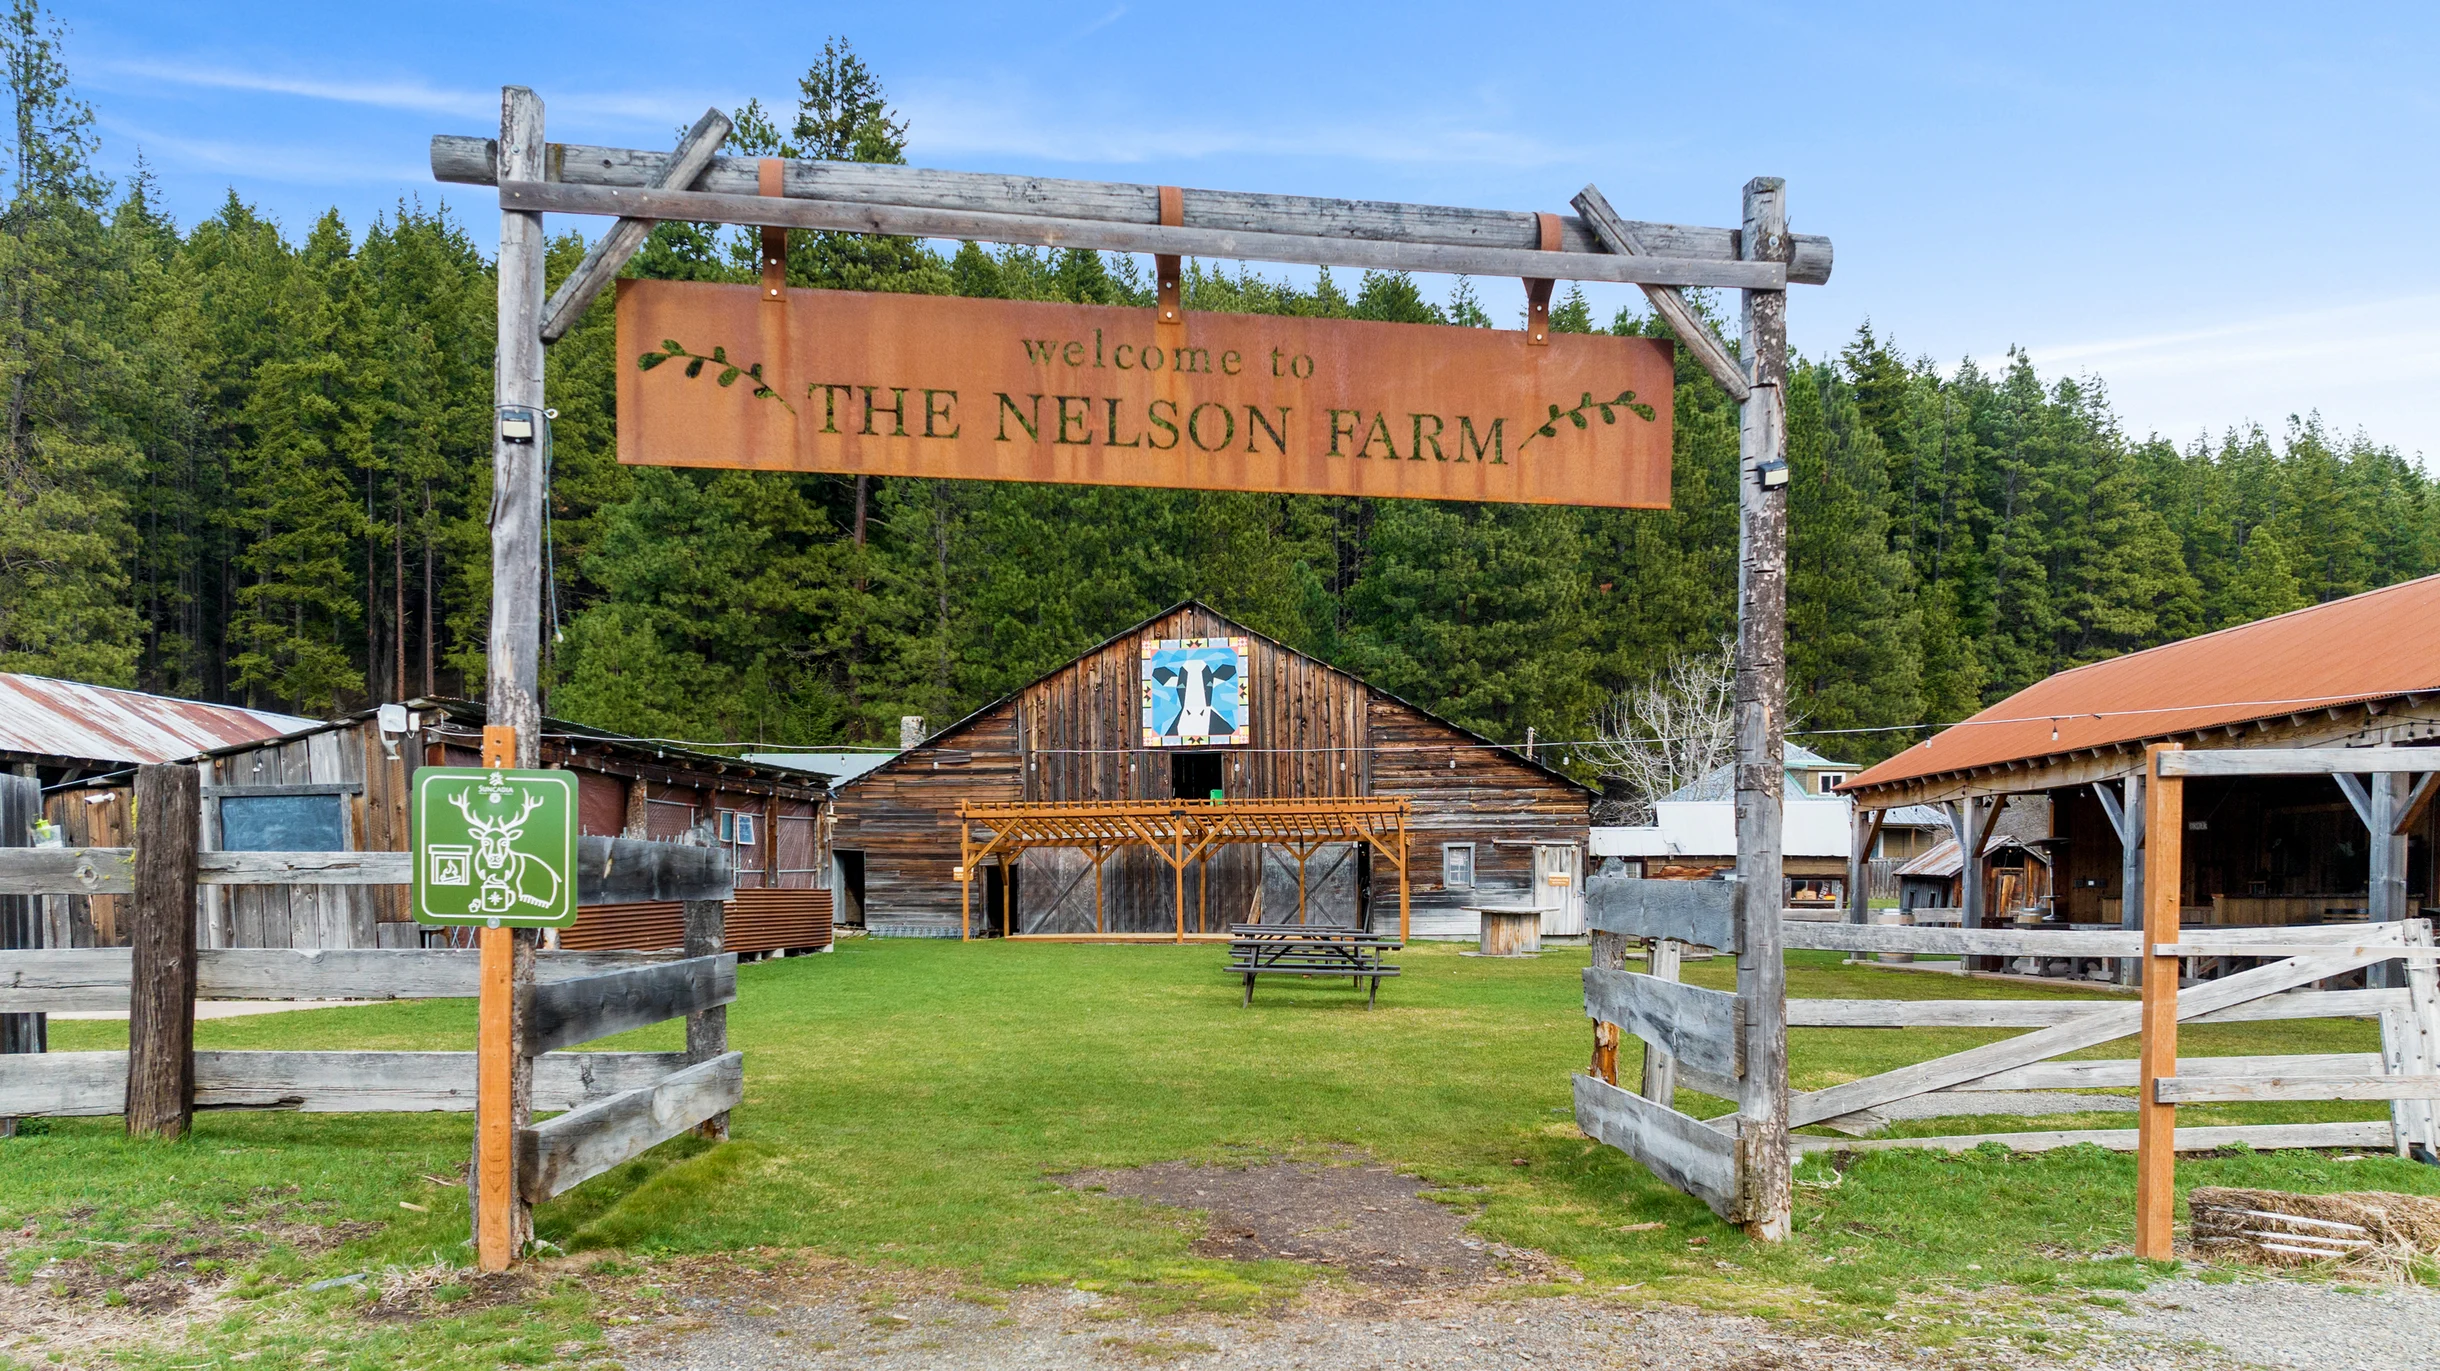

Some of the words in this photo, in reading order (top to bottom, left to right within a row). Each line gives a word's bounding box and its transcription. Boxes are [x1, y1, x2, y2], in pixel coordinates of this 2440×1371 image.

[1021, 328, 1242, 376] welcome
[1270, 345, 1315, 380] to
[807, 382, 961, 439] THE
[992, 391, 1292, 455] NELSON
[1325, 408, 1509, 465] FARM
